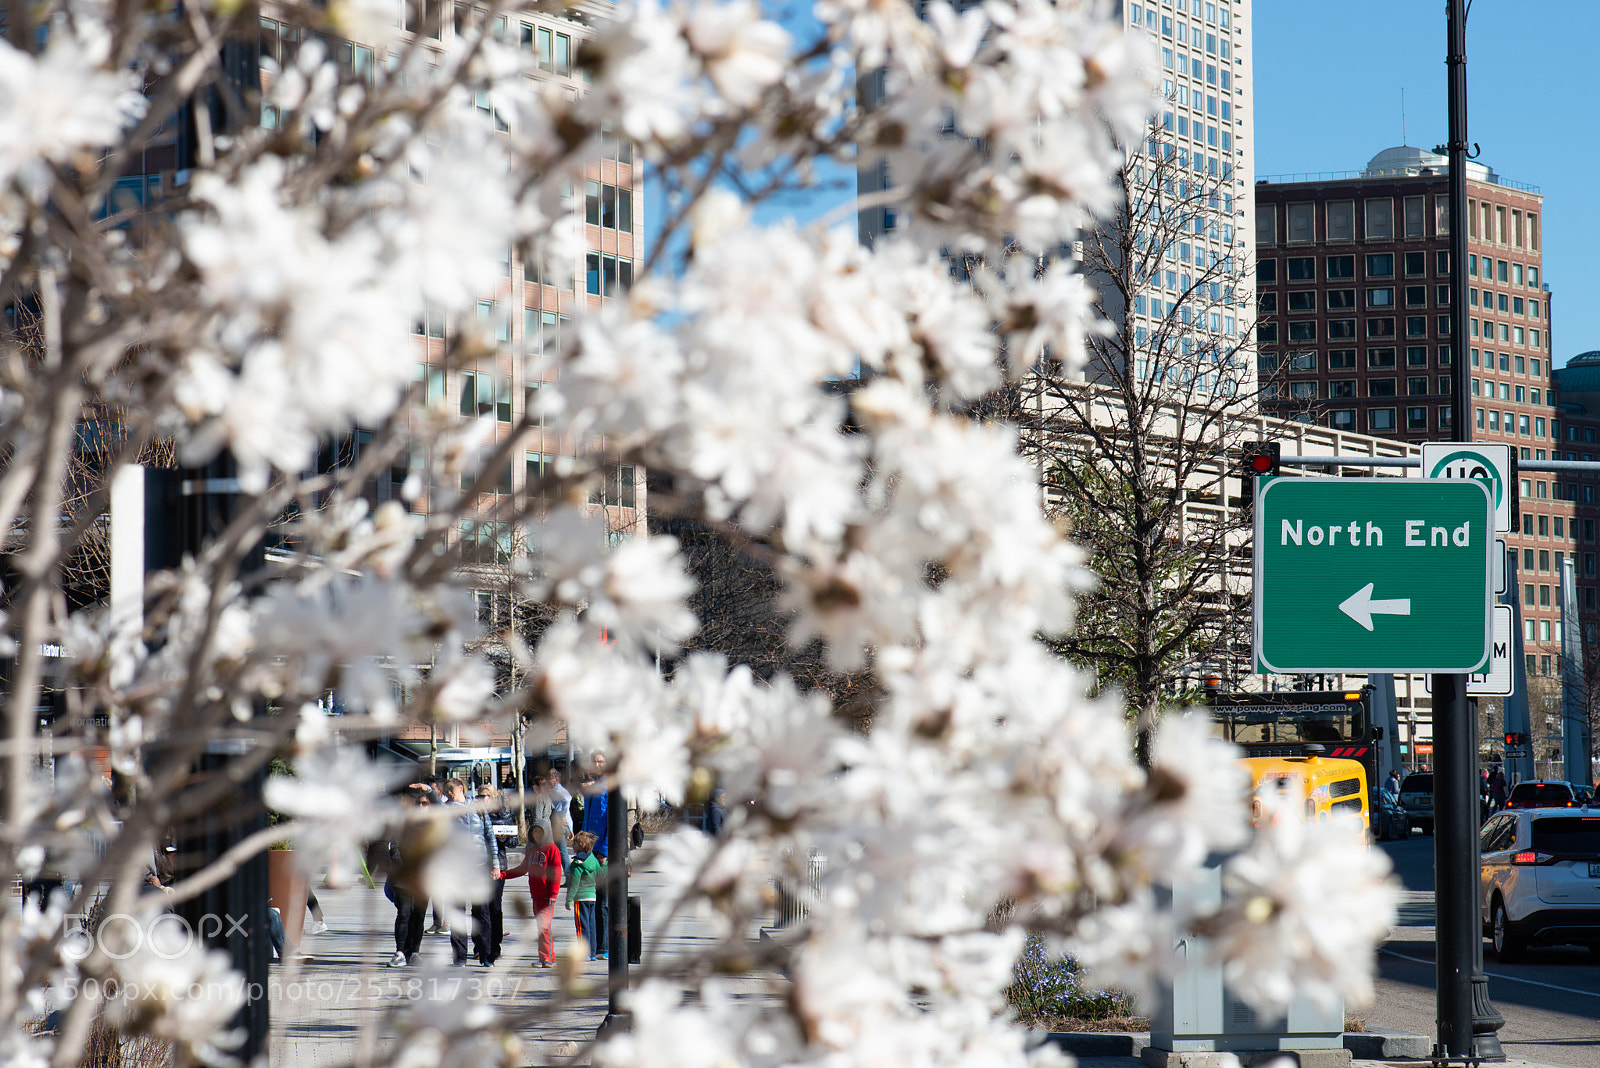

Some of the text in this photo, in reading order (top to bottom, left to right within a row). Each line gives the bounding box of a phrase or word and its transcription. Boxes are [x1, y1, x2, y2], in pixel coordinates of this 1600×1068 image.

[1281, 520, 1470, 547] North End
[1213, 702, 1347, 714] ww.powersweeping.com
